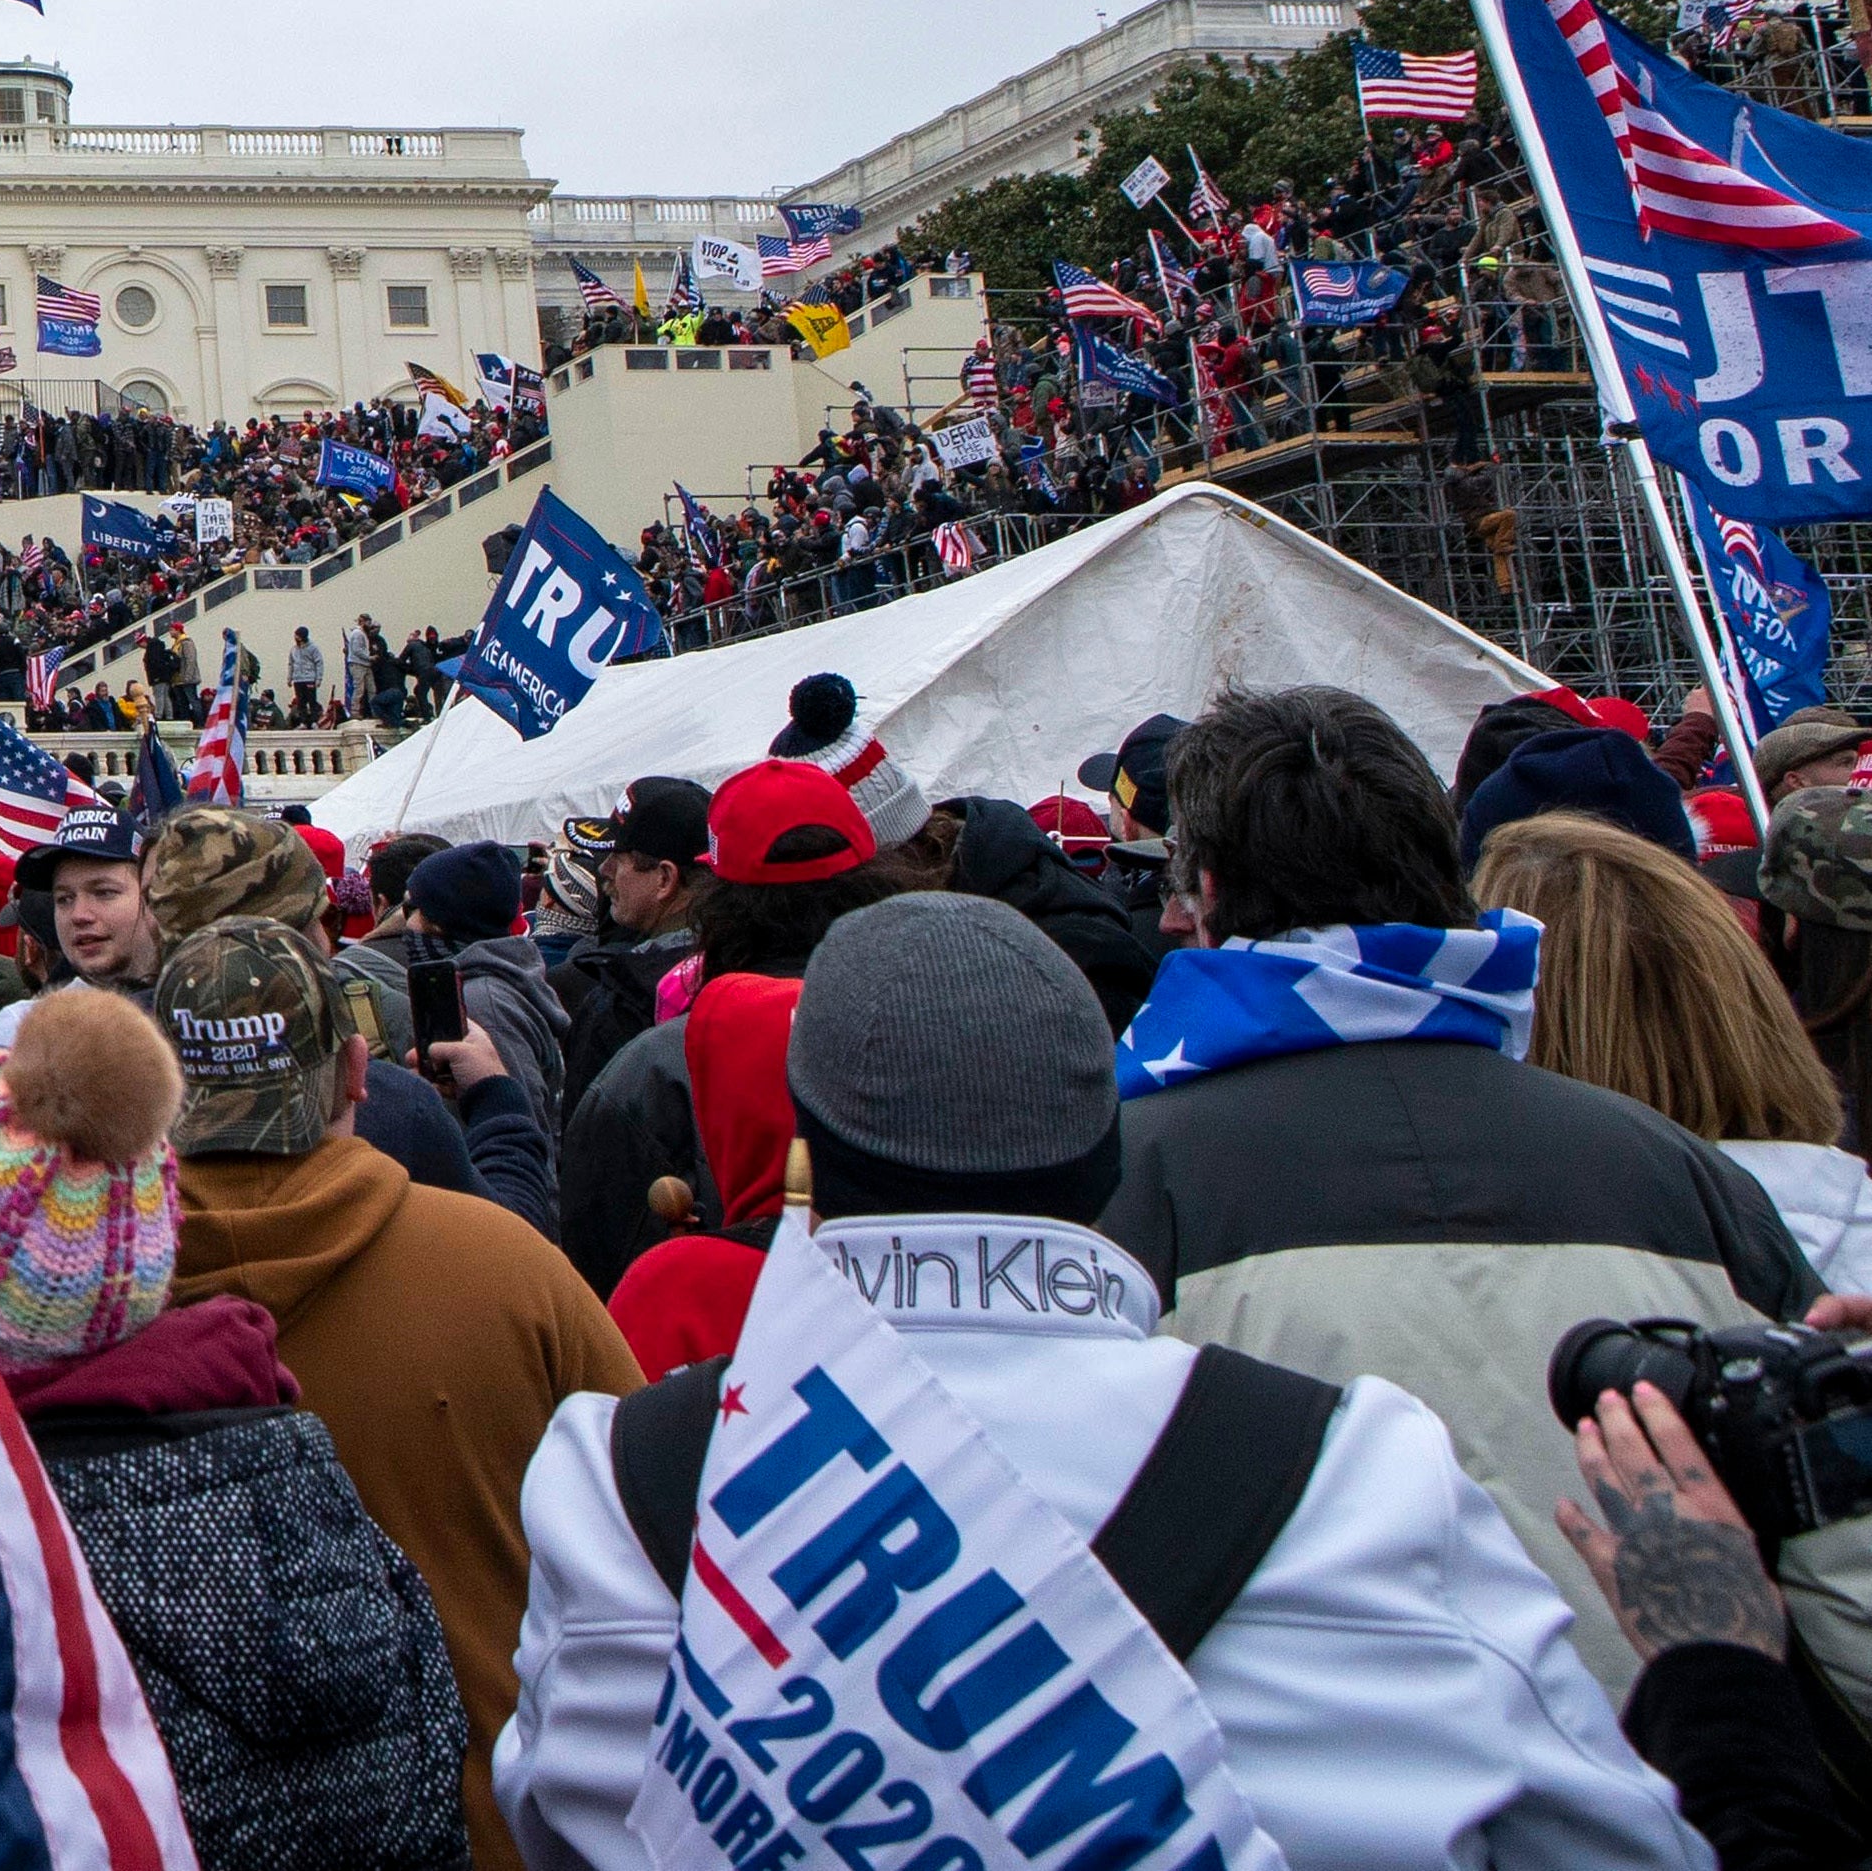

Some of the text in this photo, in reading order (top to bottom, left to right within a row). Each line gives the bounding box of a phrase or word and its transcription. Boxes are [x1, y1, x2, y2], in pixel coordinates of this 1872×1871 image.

[937, 420, 992, 448] DEFUND
[952, 440, 984, 456] THE
[332, 447, 390, 477] TRUMP
[1698, 417, 1862, 488] OR
[91, 530, 152, 555] LIBERTY
[505, 538, 628, 680] TRU
[498, 650, 567, 719] AMERICA
[62, 810, 118, 827] AMERICA
[64, 827, 108, 843] AGAIN
[173, 1008, 286, 1047] Trump
[211, 1043, 257, 1062] 2020
[267, 1056, 292, 1071] SHIT
[979, 1237, 1126, 1321] Klein
